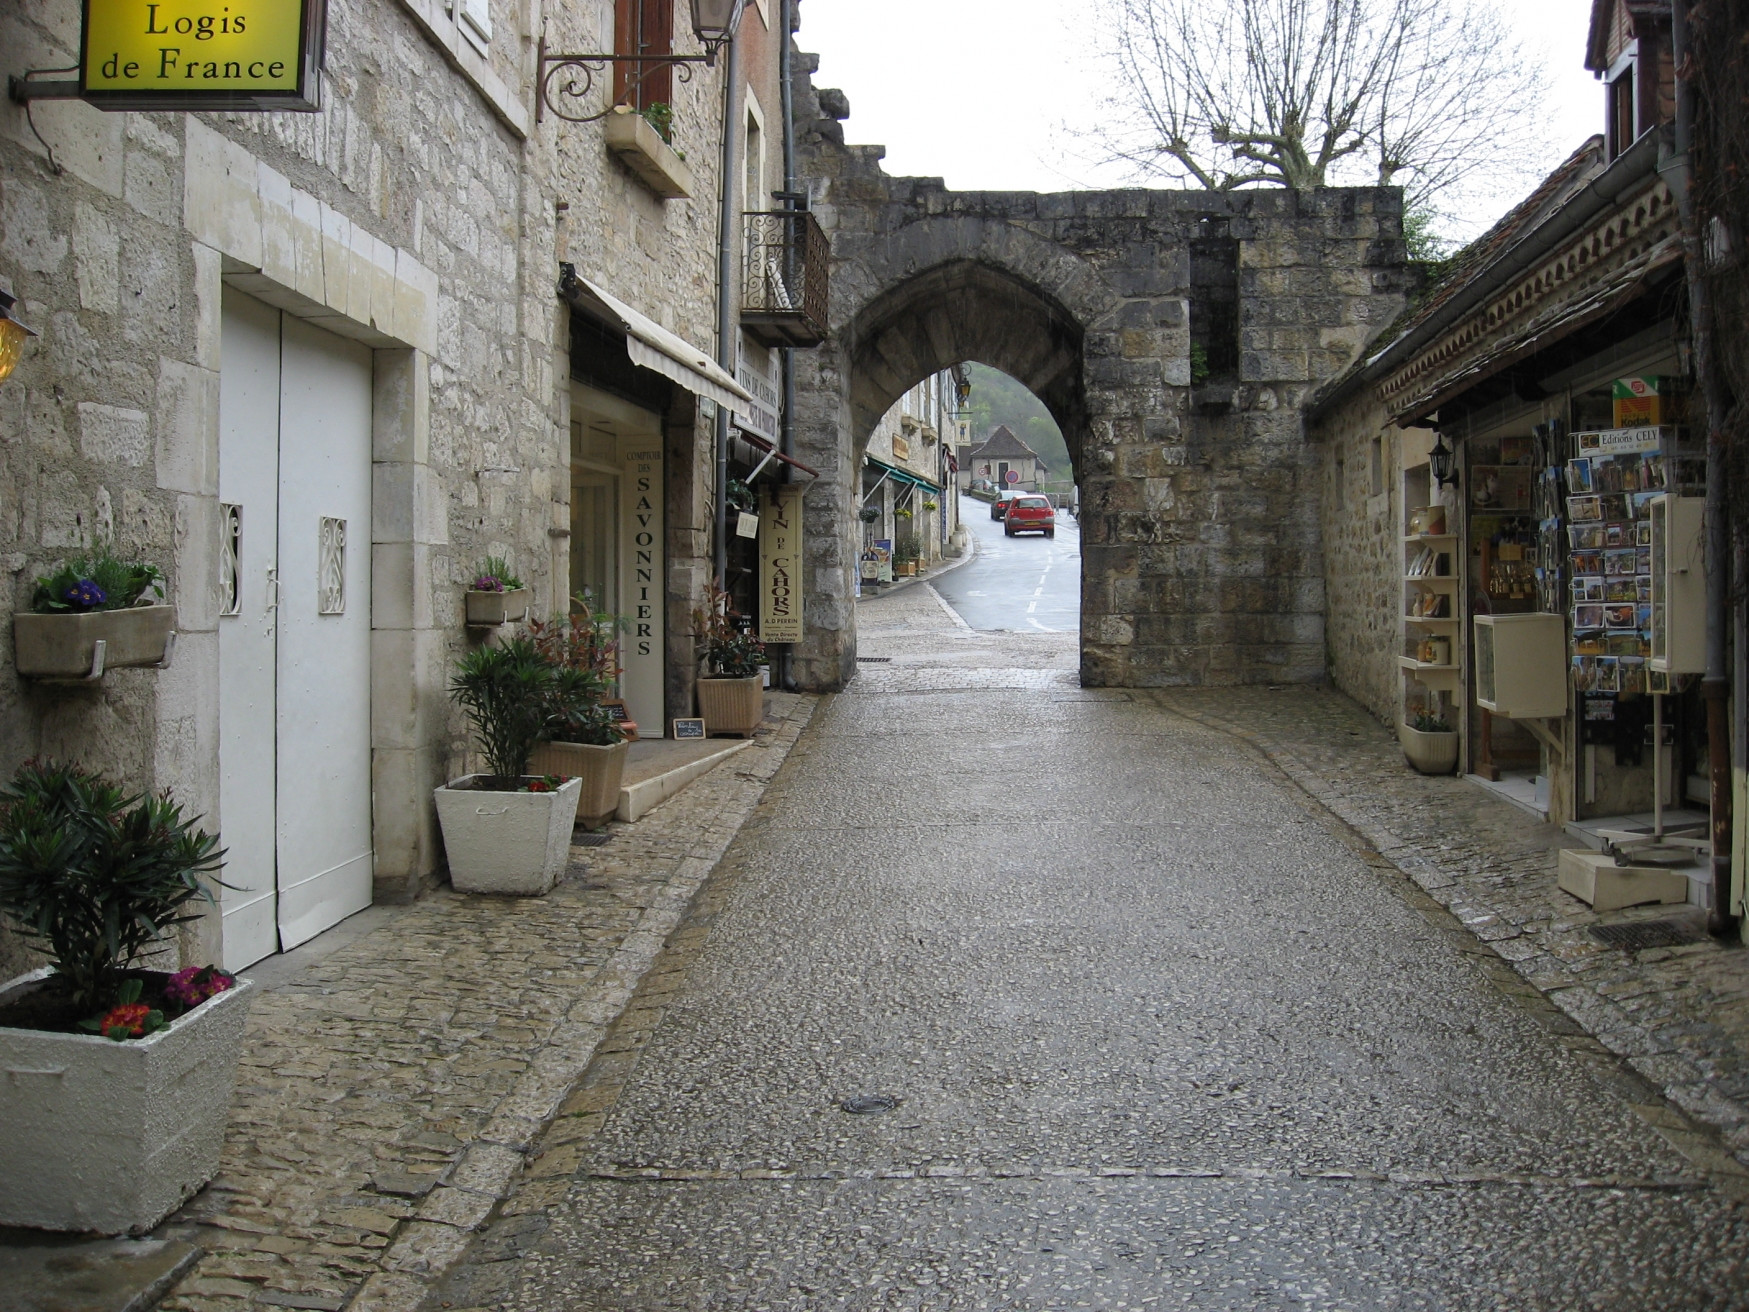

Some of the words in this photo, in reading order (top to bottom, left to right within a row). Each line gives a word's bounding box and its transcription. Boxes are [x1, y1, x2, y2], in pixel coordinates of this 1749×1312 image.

[145, 4, 246, 40] Logis
[102, 53, 139, 79] de
[156, 48, 285, 79] France
[760, 382, 777, 408] CAHORS
[1621, 416, 1651, 428] Kodak
[1601, 434, 1632, 445] Editions
[1636, 430, 1657, 442] CELY
[626, 450, 661, 460] COMPTOIR
[638, 463, 650, 472] DES
[772, 500, 790, 529] VIN
[777, 537, 785, 550] DE
[635, 477, 653, 656] SAVONNIERS
[771, 558, 790, 616] CAHORS
